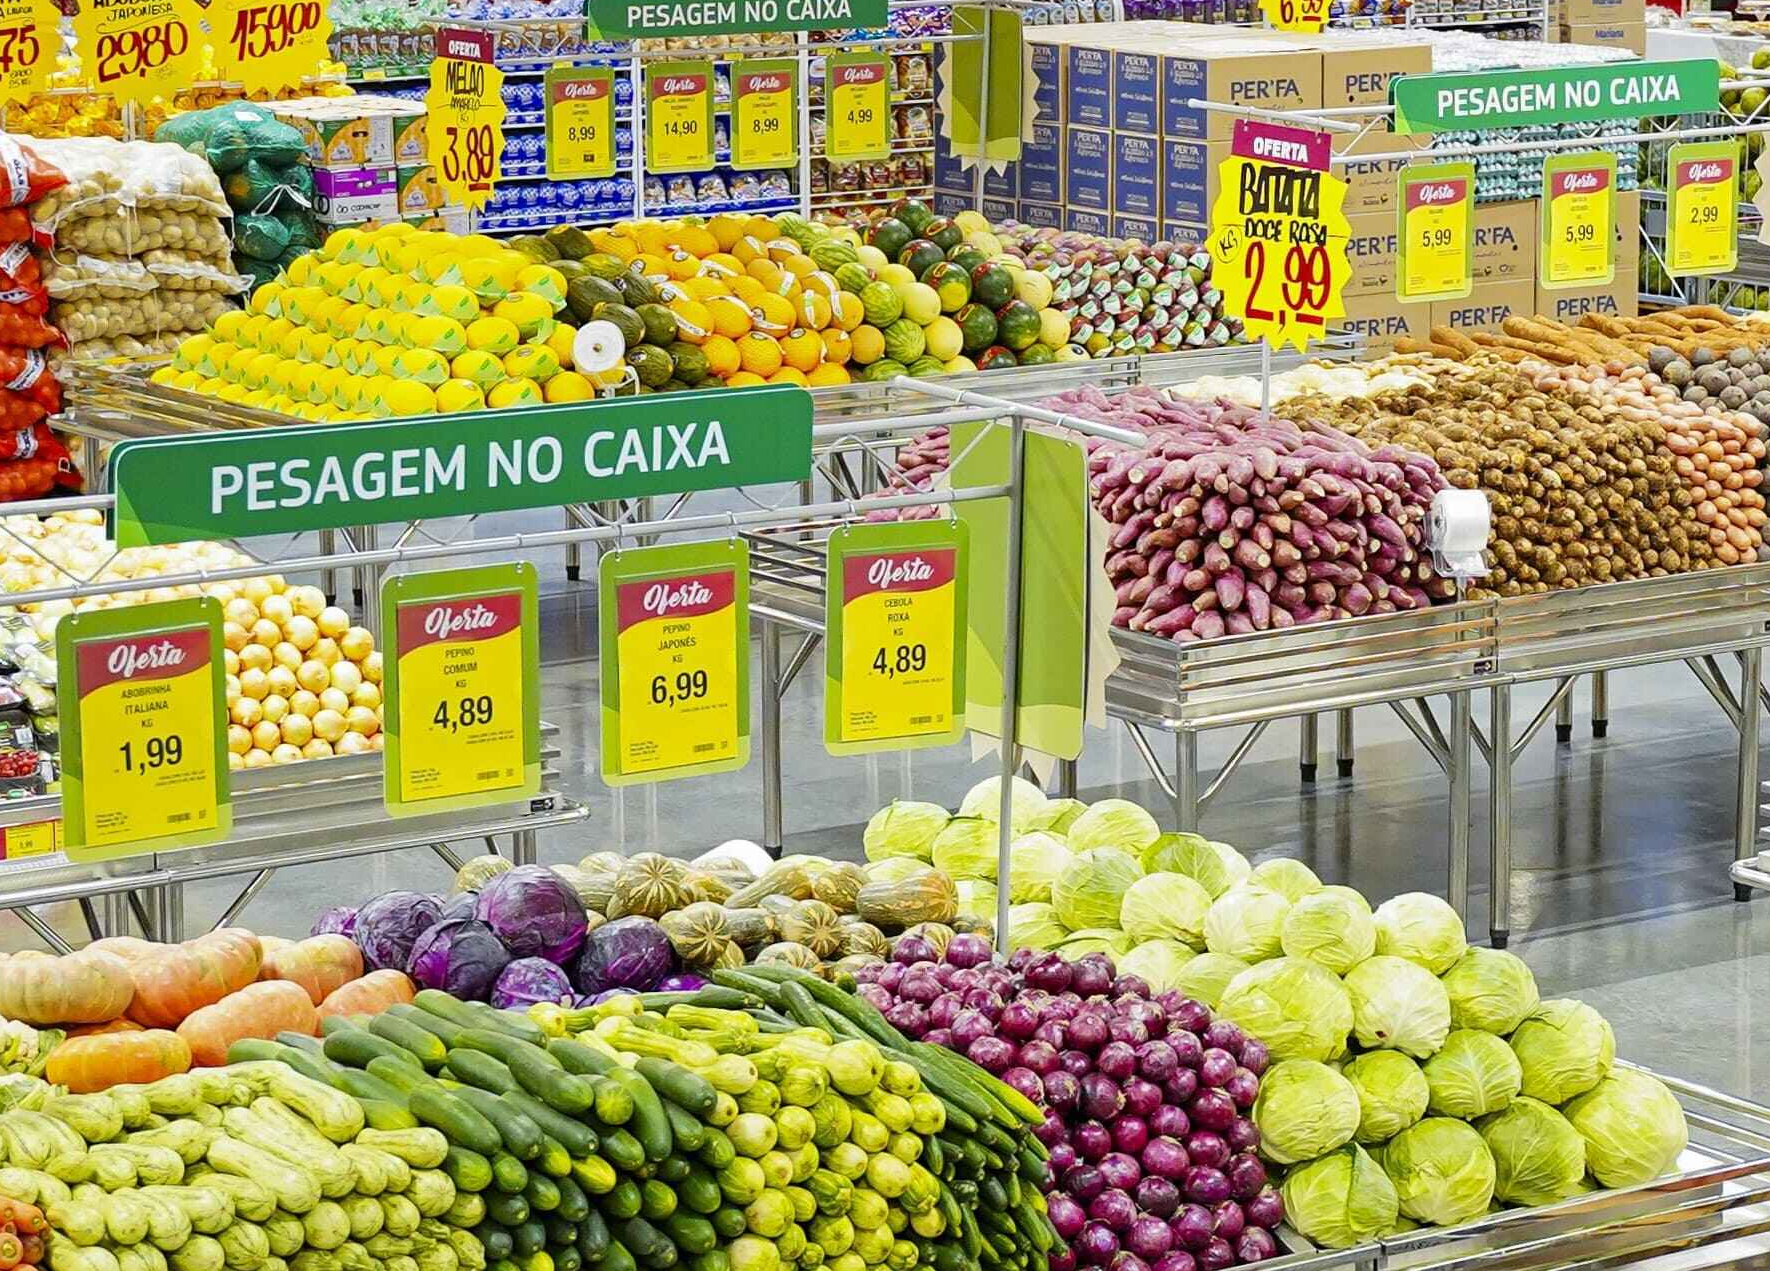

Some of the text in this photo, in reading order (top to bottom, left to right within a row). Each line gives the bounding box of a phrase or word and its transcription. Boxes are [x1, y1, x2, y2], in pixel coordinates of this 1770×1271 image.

[627, 3, 735, 28] PESAGEM
[744, 0, 777, 22] NO
[230, 2, 320, 61] 159,00
[97, 21, 188, 82] 29,80
[449, 40, 480, 57] OFERTA
[1437, 74, 1680, 118] PESAGEM NO CAIXA
[569, 126, 595, 142] 8,99
[664, 120, 697, 136] 14,90
[753, 118, 778, 134] 8,99
[1254, 137, 1308, 163] OFERTA
[1239, 163, 1321, 219] BATATA
[1691, 206, 1719, 226] 2,99
[1245, 218, 1327, 247] DOCE ROSA
[1423, 228, 1451, 248] 5,99
[1567, 224, 1594, 244] 5,99
[1245, 241, 1331, 334] 2,99
[212, 420, 730, 514] PESAGEM NO CAIXA
[868, 556, 935, 588] Oferta
[643, 580, 712, 615] Oferta
[884, 597, 913, 608] CEBOLA
[425, 604, 497, 639] Oferta
[887, 612, 910, 623] ROXA
[108, 642, 187, 674] Oferta
[444, 661, 478, 675] COMUM
[873, 644, 926, 679] 4,89
[651, 670, 708, 708] 6,99
[434, 696, 493, 735] 4,89
[119, 735, 183, 776] 1,99
